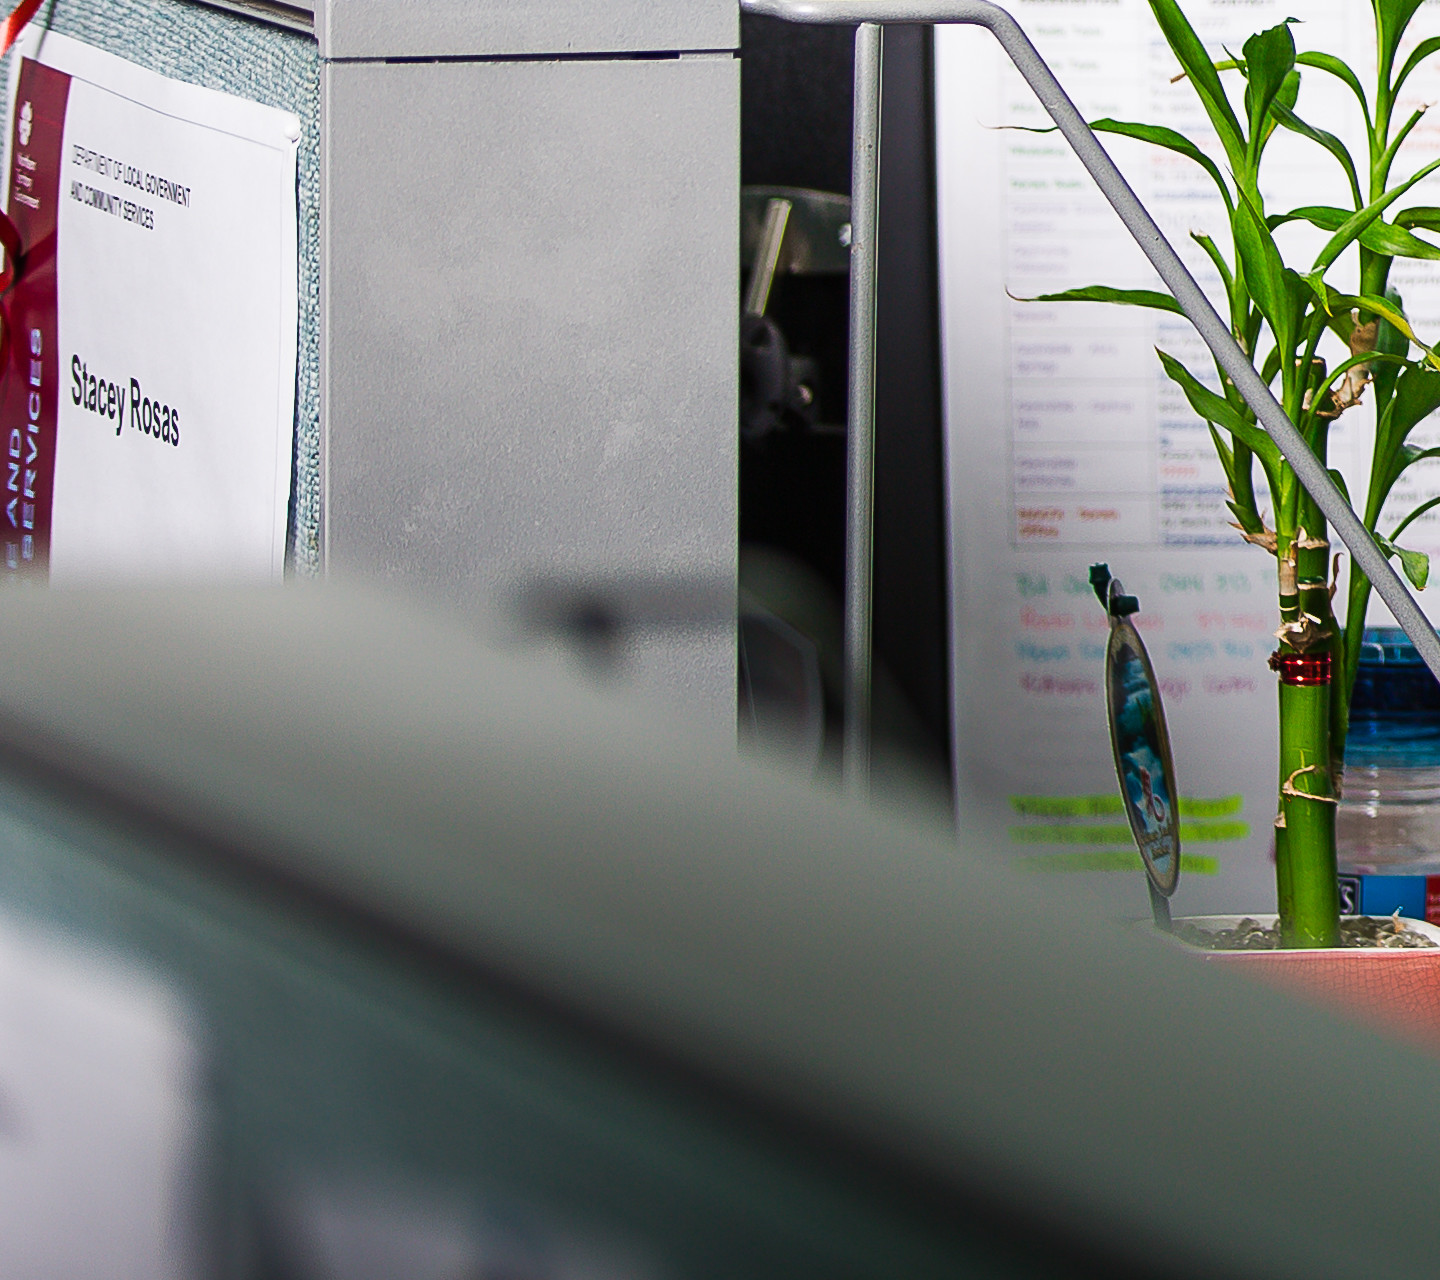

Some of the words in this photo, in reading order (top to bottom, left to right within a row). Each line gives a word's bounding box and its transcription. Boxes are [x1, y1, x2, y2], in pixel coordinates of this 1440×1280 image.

[123, 165, 145, 191] LOCAL
[145, 173, 191, 208] GOVERNMENT
[123, 200, 154, 230] SERVICES
[22, 328, 42, 561] SERVICES
[71, 354, 126, 436] Stacey
[130, 377, 180, 447] Rosas
[7, 428, 20, 528] AND
